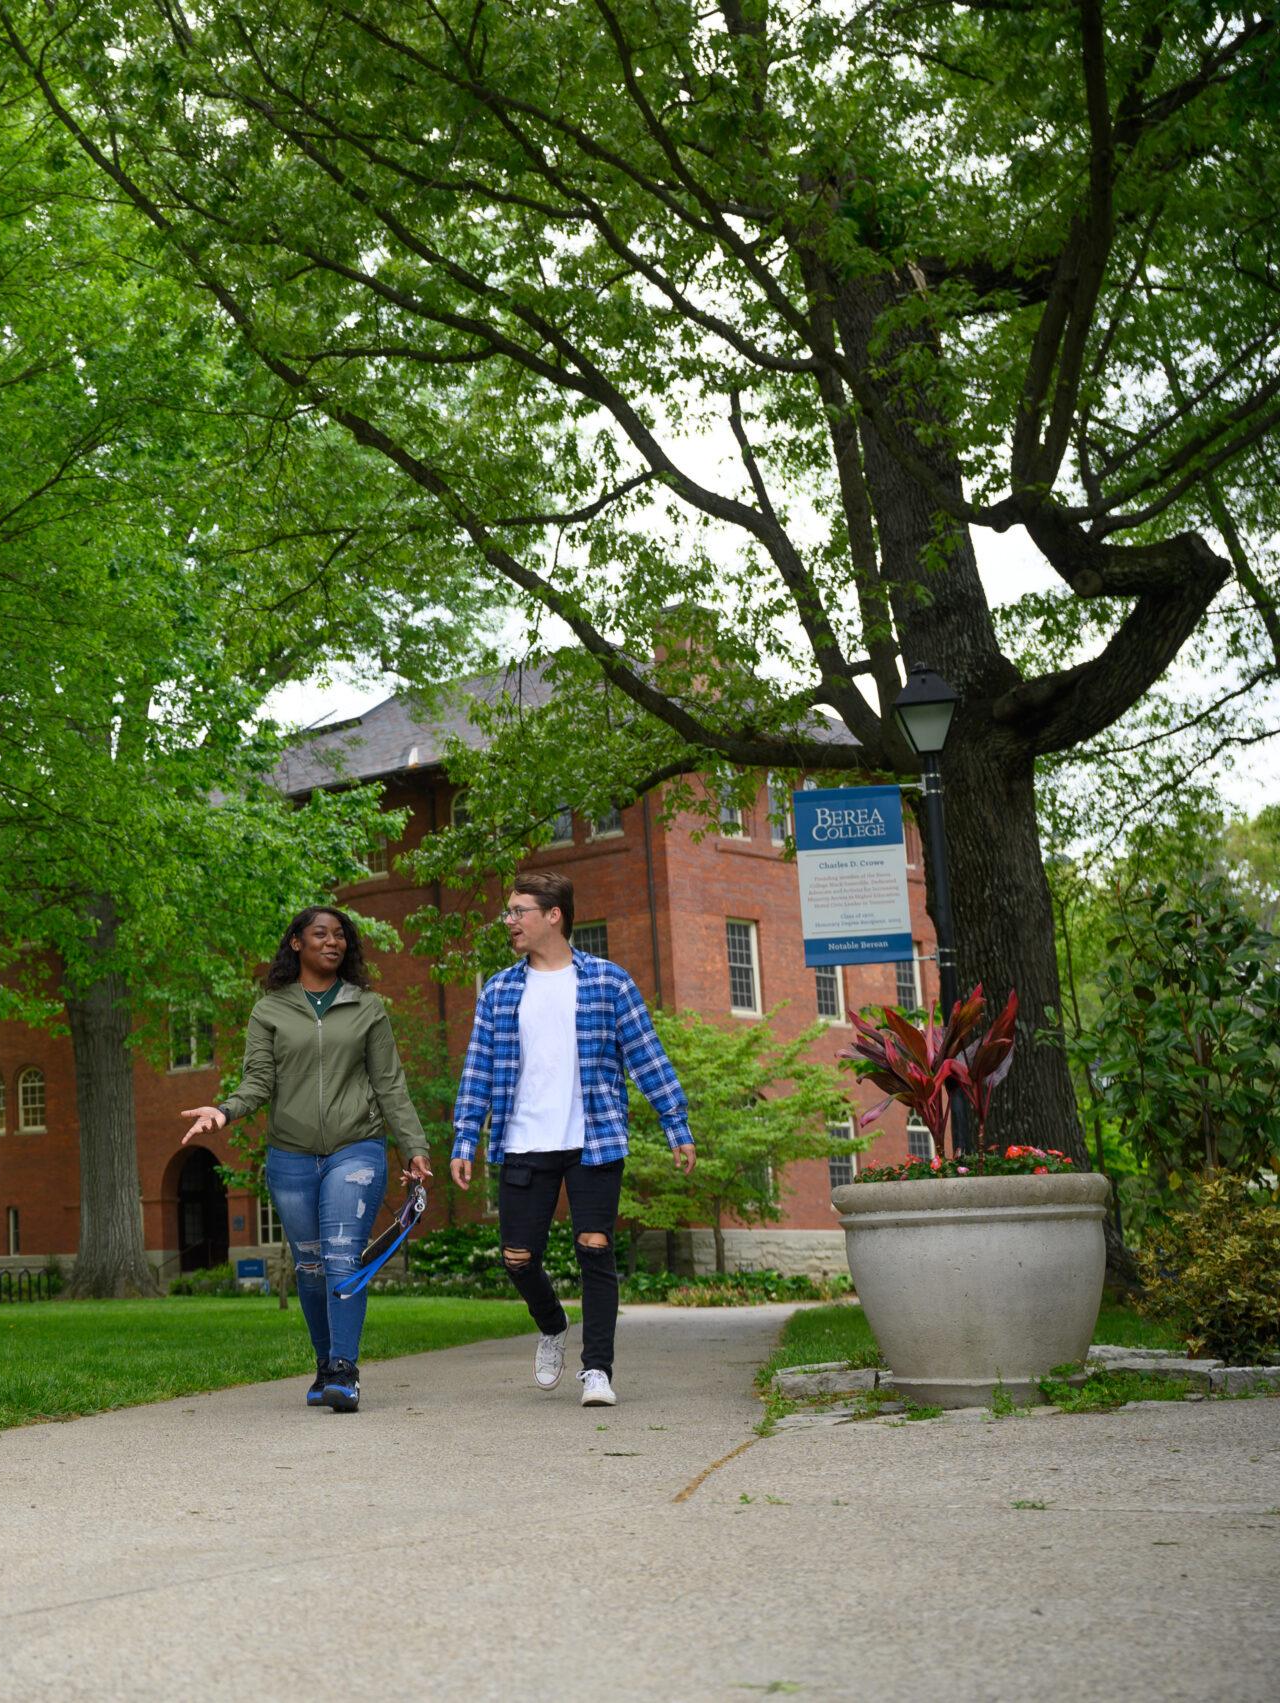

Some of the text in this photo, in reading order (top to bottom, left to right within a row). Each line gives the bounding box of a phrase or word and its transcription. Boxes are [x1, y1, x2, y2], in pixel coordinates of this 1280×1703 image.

[816, 808, 884, 827] BEREA
[812, 824, 886, 841] COLLEGE
[819, 859, 884, 870] Charles D. Crowe
[828, 940, 888, 951] Notable Berean
